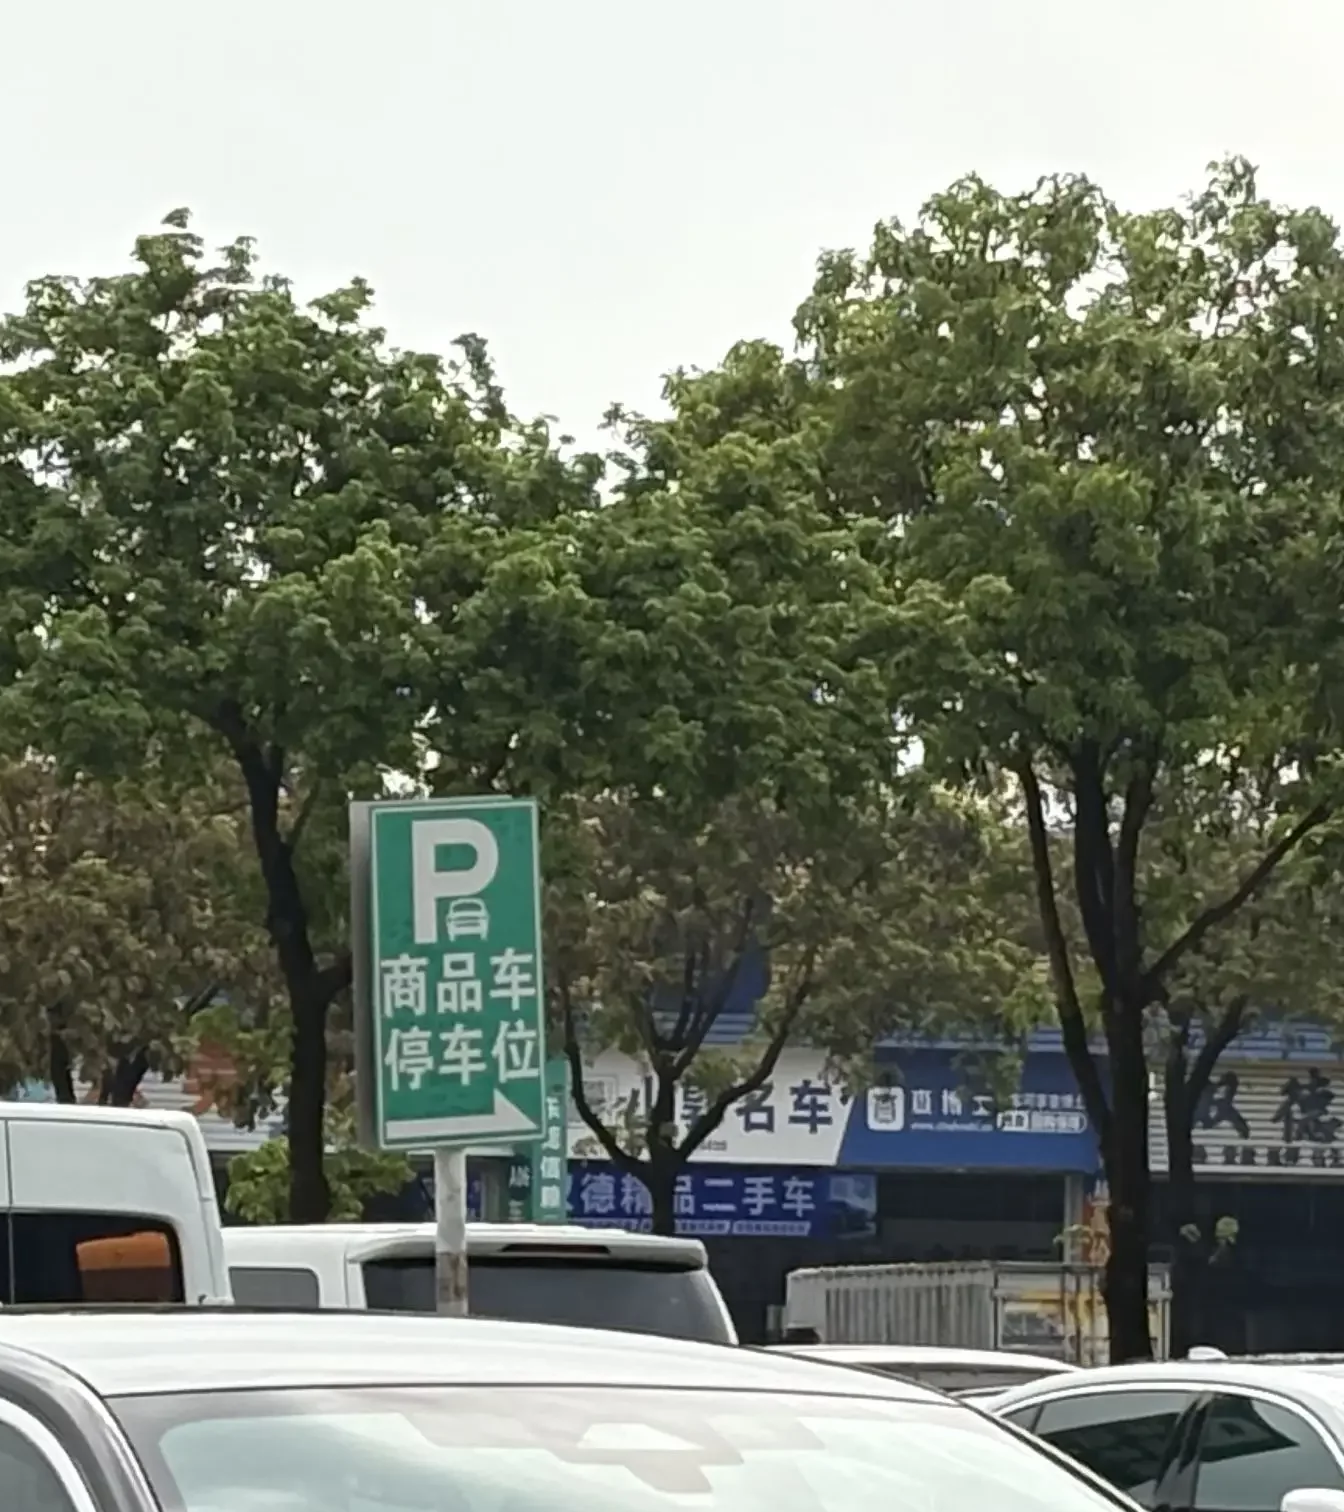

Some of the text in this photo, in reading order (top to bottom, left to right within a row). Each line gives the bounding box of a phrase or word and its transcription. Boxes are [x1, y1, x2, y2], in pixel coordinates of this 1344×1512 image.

[412, 818, 499, 945] P
[380, 947, 537, 1018] 商品车
[384, 1019, 540, 1091] 停车位
[564, 1172, 816, 1218] 德精品二手车
